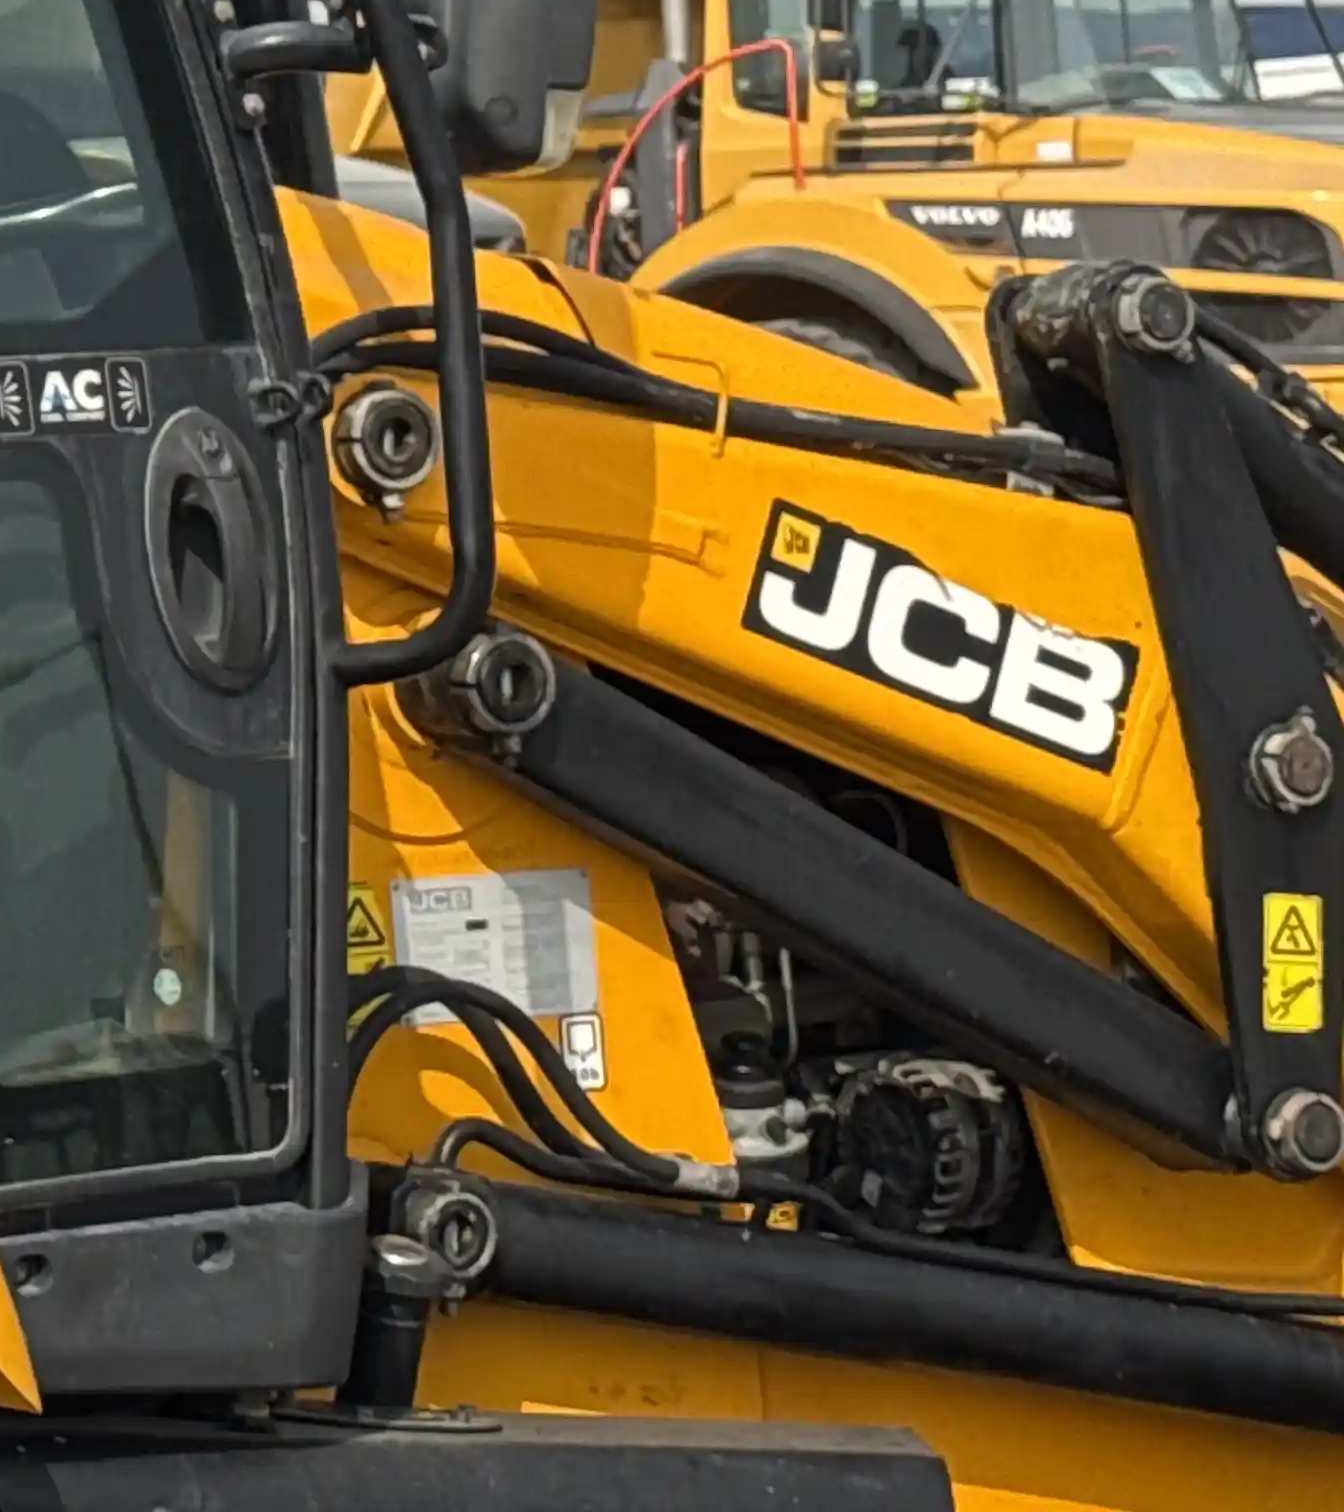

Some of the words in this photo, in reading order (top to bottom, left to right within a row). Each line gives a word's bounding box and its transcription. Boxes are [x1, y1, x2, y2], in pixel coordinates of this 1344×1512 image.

[910, 205, 1000, 226] VOLVO
[40, 369, 105, 411] AC
[759, 538, 1124, 755] JCB
